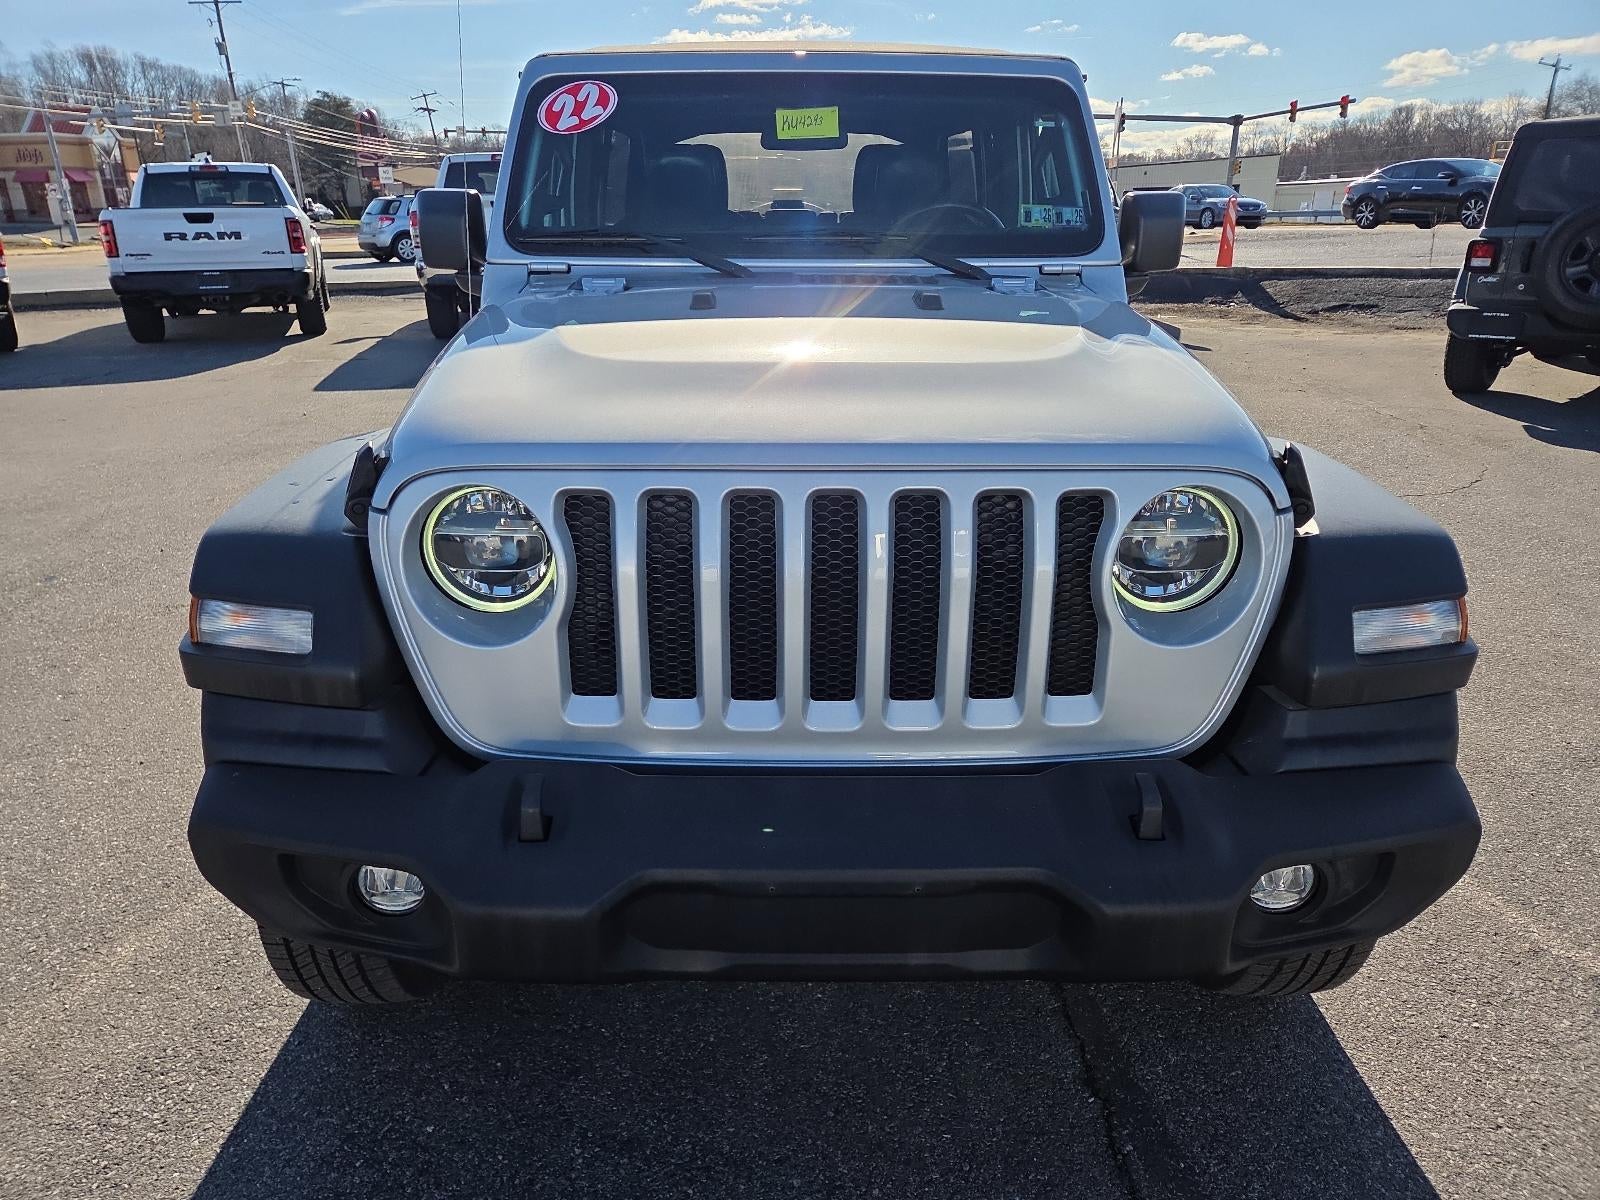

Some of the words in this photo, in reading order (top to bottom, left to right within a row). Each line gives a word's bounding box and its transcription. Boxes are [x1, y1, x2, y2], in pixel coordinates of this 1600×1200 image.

[553, 83, 604, 131] 22
[1043, 208, 1052, 223] 26
[1075, 209, 1083, 223] 26
[163, 231, 242, 241] RAM
